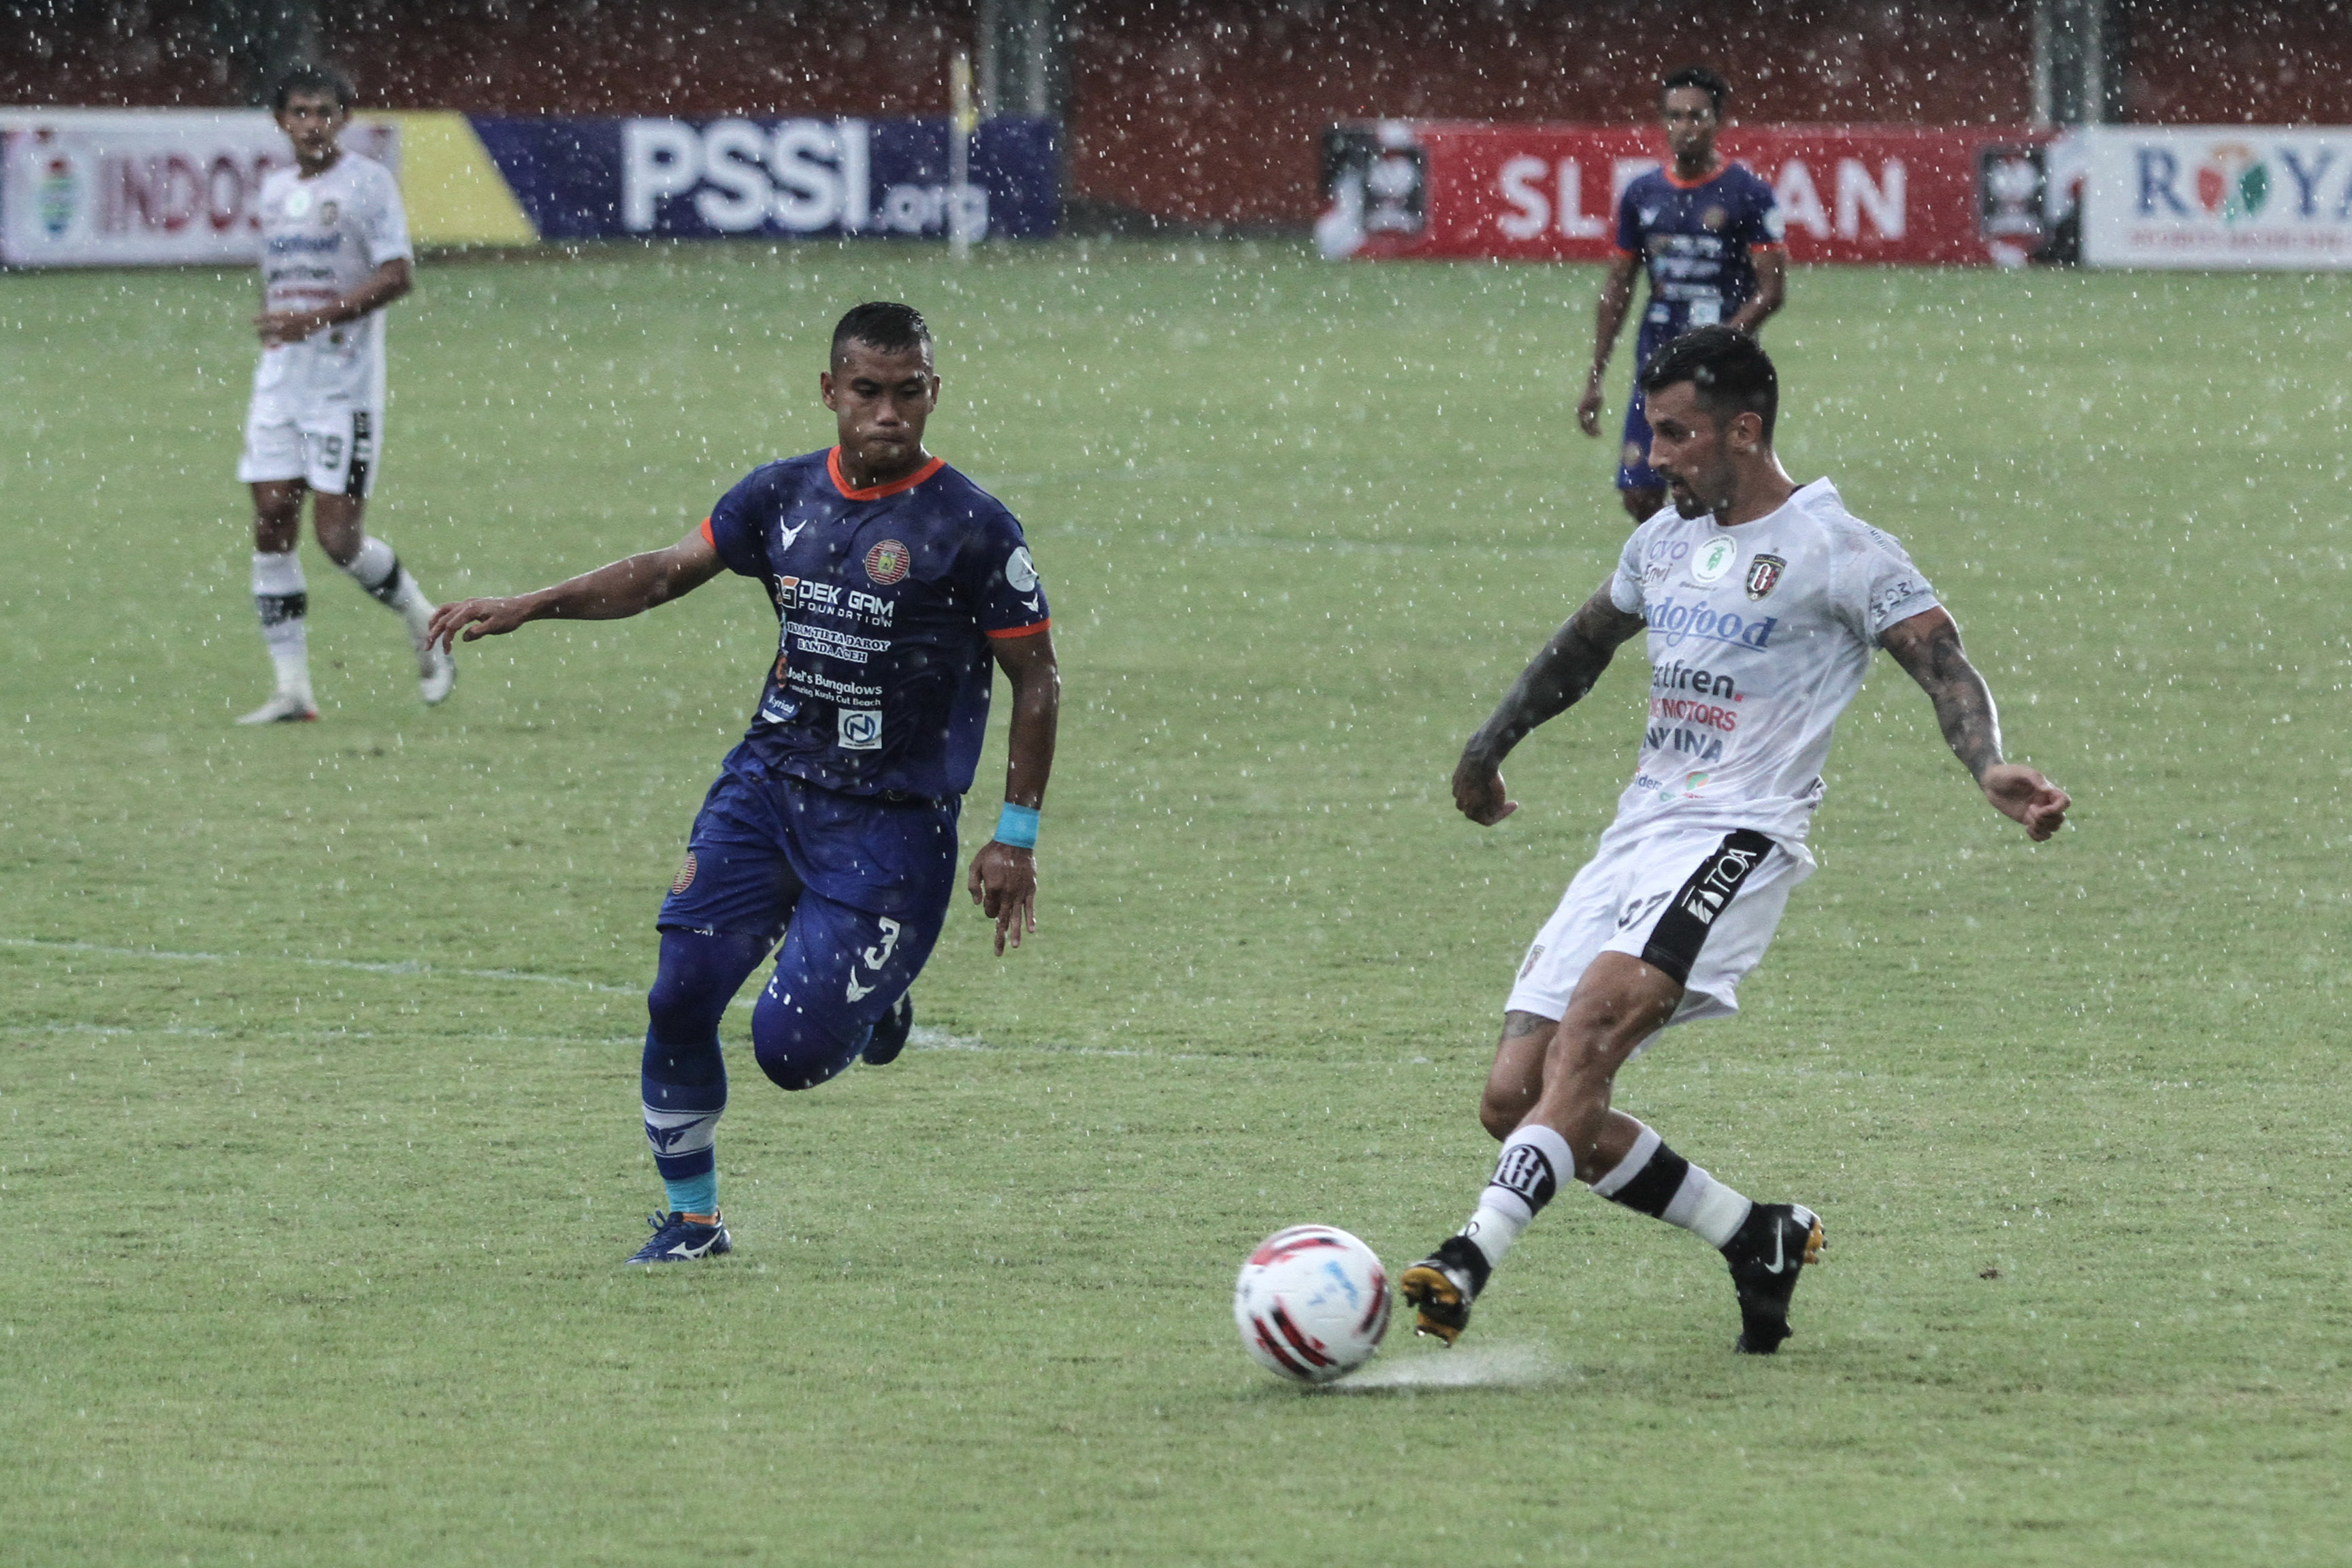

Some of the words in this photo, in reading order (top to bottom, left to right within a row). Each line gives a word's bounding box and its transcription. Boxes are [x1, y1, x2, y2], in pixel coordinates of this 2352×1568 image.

[799, 579, 843, 605] DEK
[848, 590, 895, 618] GAM
[798, 601, 893, 628] FOUNDATION
[835, 647, 868, 664] ACEH
[846, 635, 892, 652] DAROY
[786, 666, 813, 684] Joel's
[814, 673, 883, 696] Bungalows
[767, 694, 796, 714] Kyriad
[836, 694, 851, 705] Cut
[852, 698, 882, 707] Beach
[1661, 697, 1738, 732] MOTORS
[863, 915, 901, 971] 3
